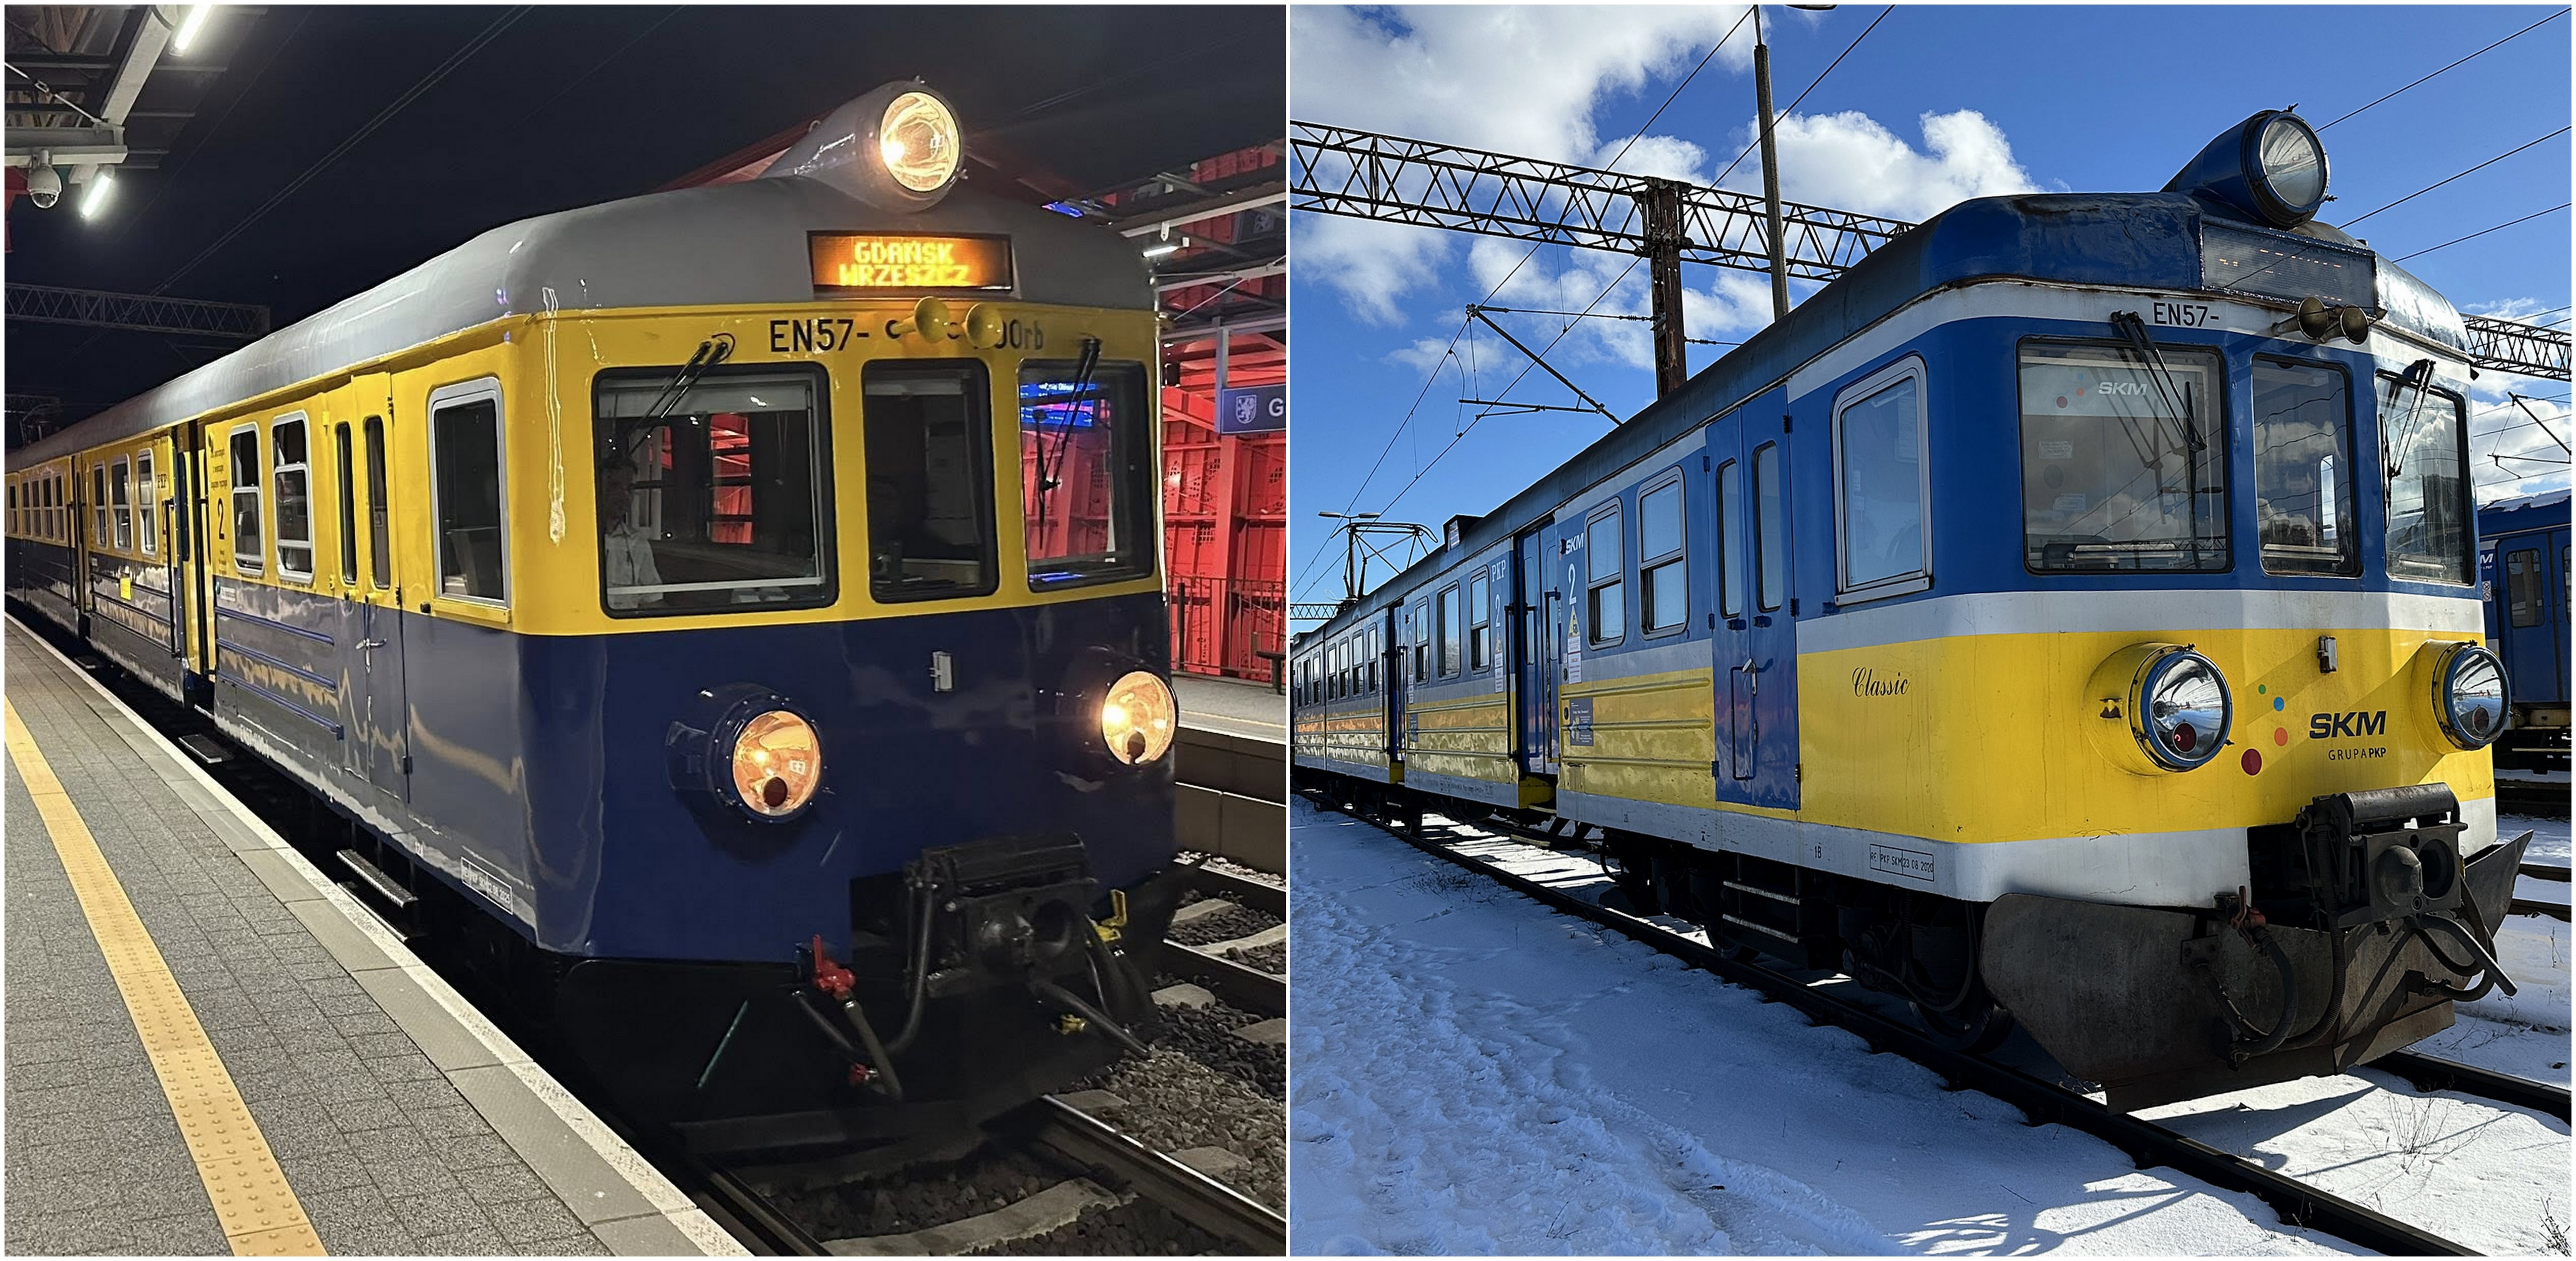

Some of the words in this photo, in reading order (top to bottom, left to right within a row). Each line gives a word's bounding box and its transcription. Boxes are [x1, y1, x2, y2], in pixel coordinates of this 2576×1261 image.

[854, 240, 954, 265] GDAŃSK
[839, 263, 973, 286] WRZESZCZ
[2153, 302, 2219, 327] EN57-
[2098, 381, 2147, 396] SKM
[217, 498, 225, 540] 2
[1565, 532, 1584, 555] SKM
[1491, 559, 1506, 583] PKP
[1568, 563, 1577, 605] 2
[1495, 594, 1501, 627] 2
[1852, 667, 1911, 697] Classic
[2309, 710, 2387, 739] SKM
